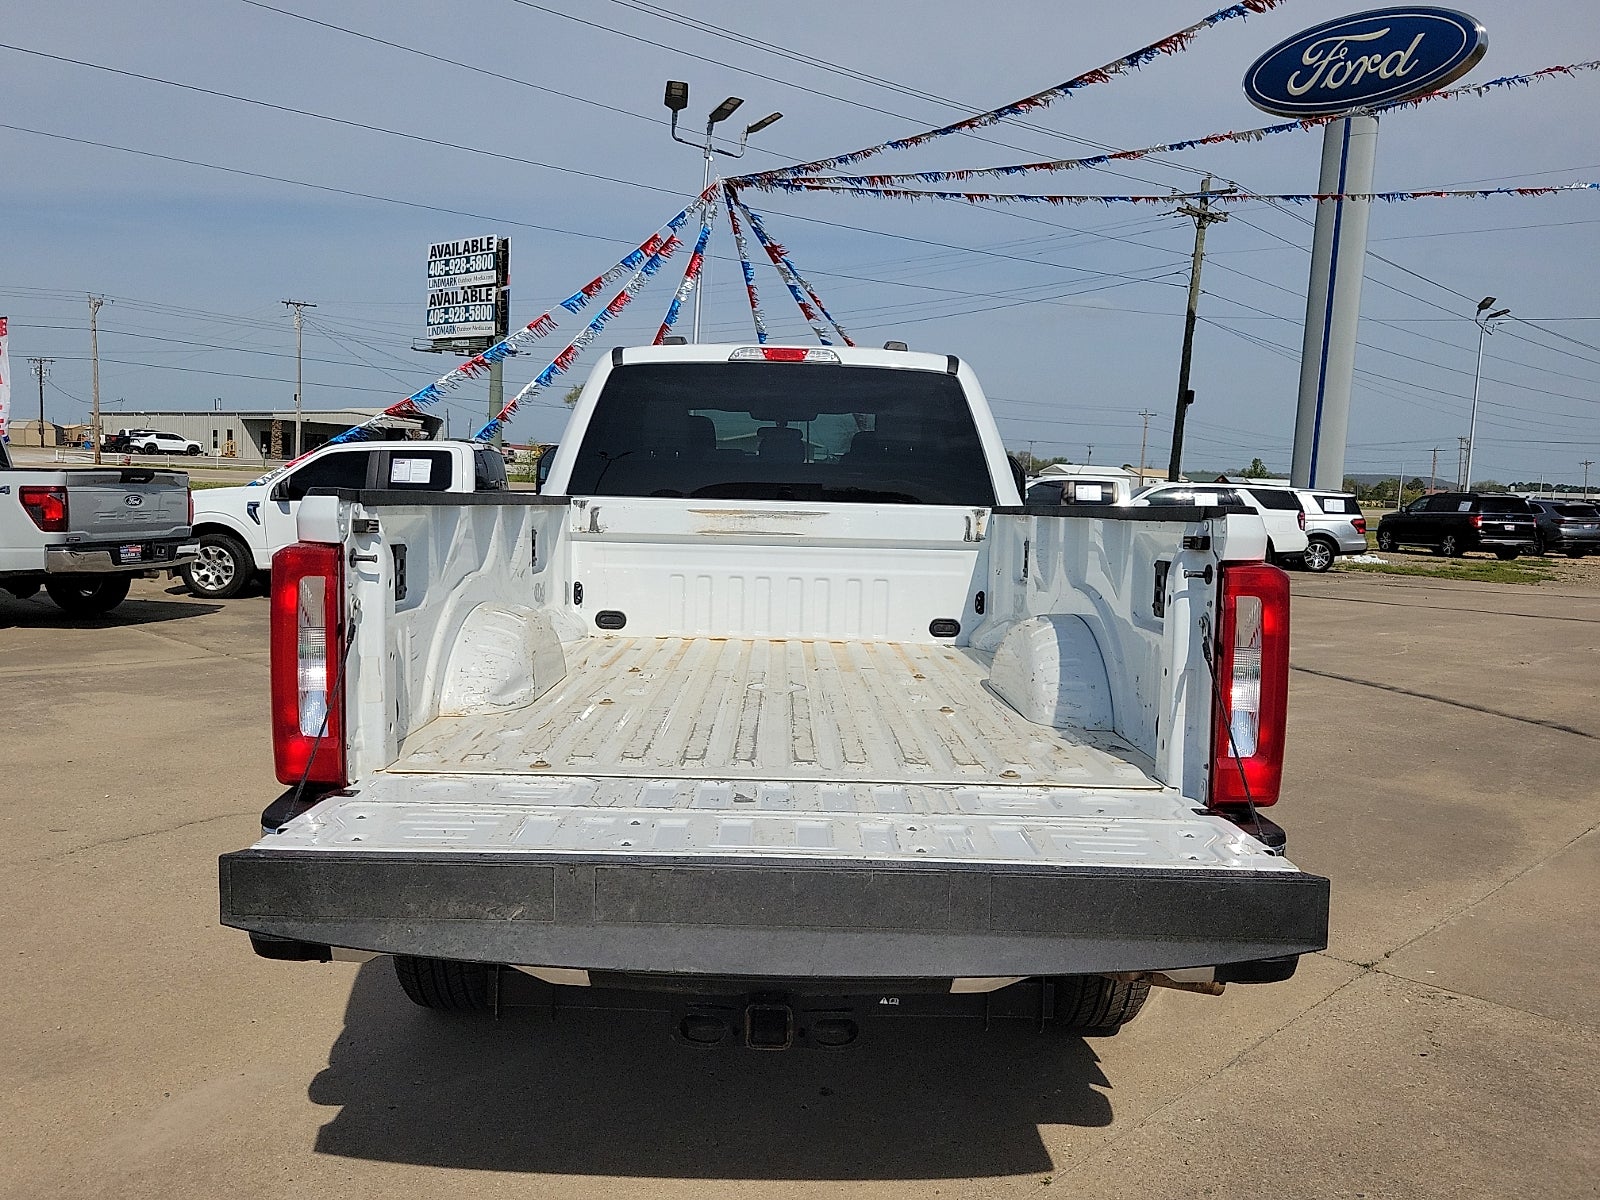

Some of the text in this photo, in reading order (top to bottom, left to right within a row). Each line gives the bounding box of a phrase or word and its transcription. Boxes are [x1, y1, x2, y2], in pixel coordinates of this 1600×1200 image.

[1287, 27, 1425, 96] Ford
[429, 236, 494, 259] AVAILABLE
[429, 254, 494, 277] 405-928-5800
[428, 276, 457, 289] LINDMARK
[429, 287, 493, 308] AVAILABLE
[428, 305, 493, 324] 405-928-5800
[428, 325, 457, 337] LINDMARK
